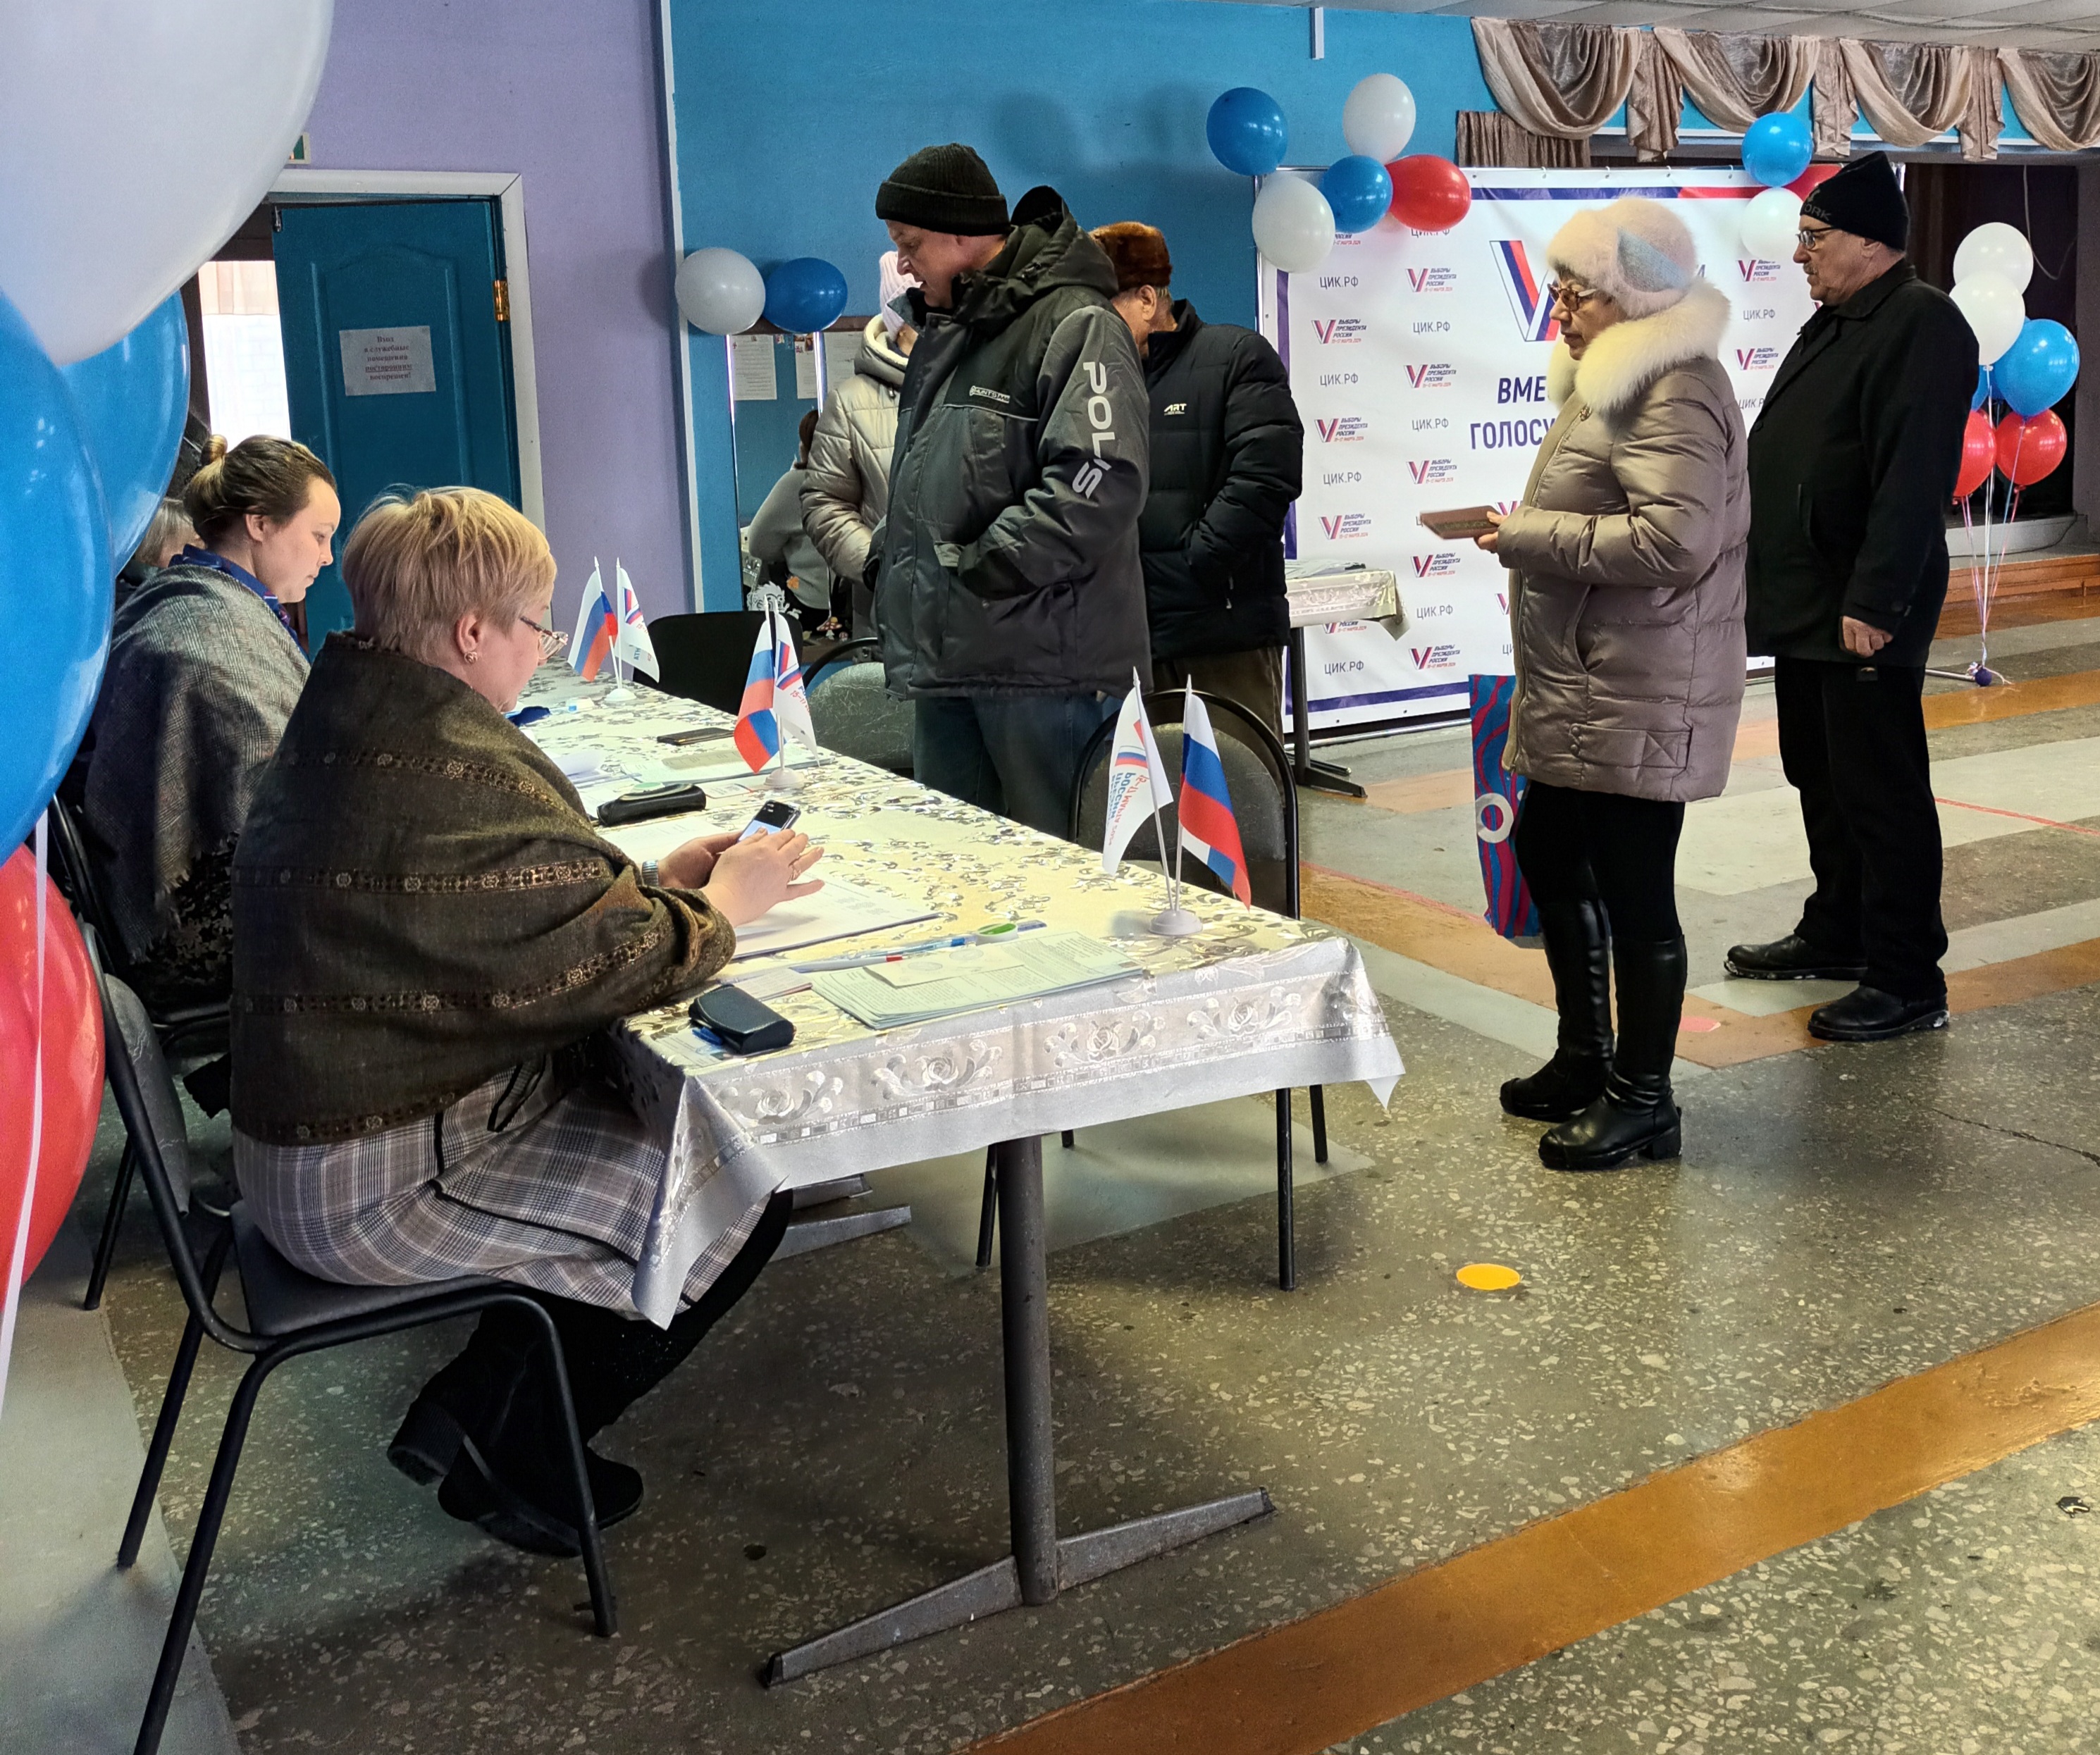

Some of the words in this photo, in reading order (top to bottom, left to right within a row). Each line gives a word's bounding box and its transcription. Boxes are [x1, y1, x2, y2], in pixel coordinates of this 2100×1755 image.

[1804, 203, 1832, 221] ORK
[1319, 276, 1359, 290] ЦИК.РФ
[1743, 309, 1776, 321] ЦИК.РФ
[1413, 321, 1451, 335] ЦИК.РФ
[1320, 373, 1359, 387] ЦИК.РФ
[1497, 376, 1548, 404] ВМЕ
[1738, 398, 1765, 410] ЦИК.Р
[1412, 418, 1449, 432] ЦИК.РФ
[1323, 471, 1362, 486] ЦИК.РФ
[1416, 604, 1453, 619] ЦИК.РФ
[1324, 660, 1364, 675] ЦИК.РФ
